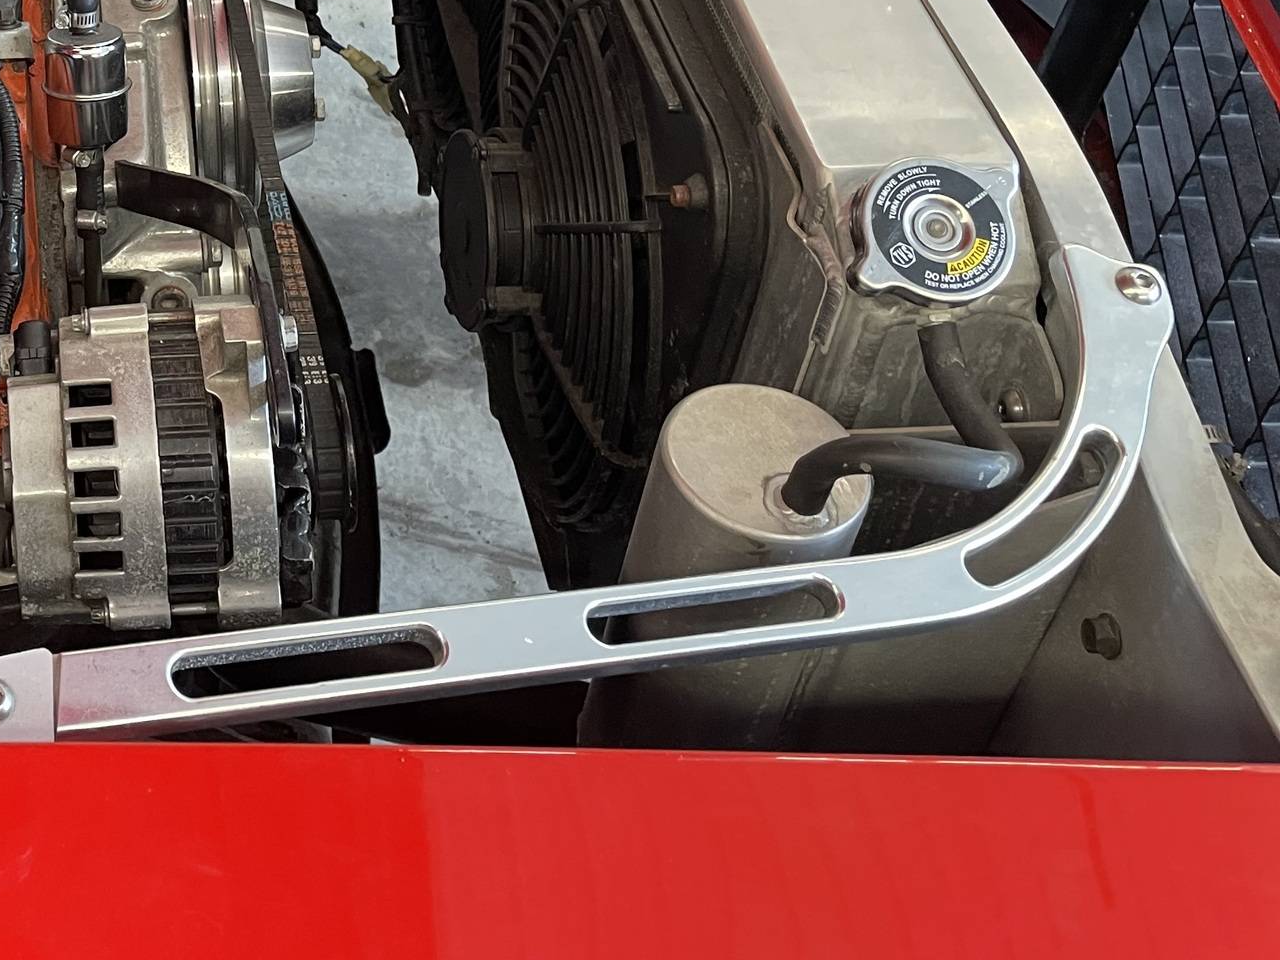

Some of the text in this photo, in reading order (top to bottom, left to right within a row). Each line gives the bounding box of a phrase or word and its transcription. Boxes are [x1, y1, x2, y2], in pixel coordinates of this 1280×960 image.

[876, 166, 928, 207] REMOVE SLOWLY
[888, 178, 941, 220] TURN DOWN TIGHT
[891, 244, 914, 266] TVS
[924, 221, 1000, 283] DO NOT OPEN WHEN HOT
[957, 239, 989, 271] CAUTION
[924, 279, 940, 289] TEST
